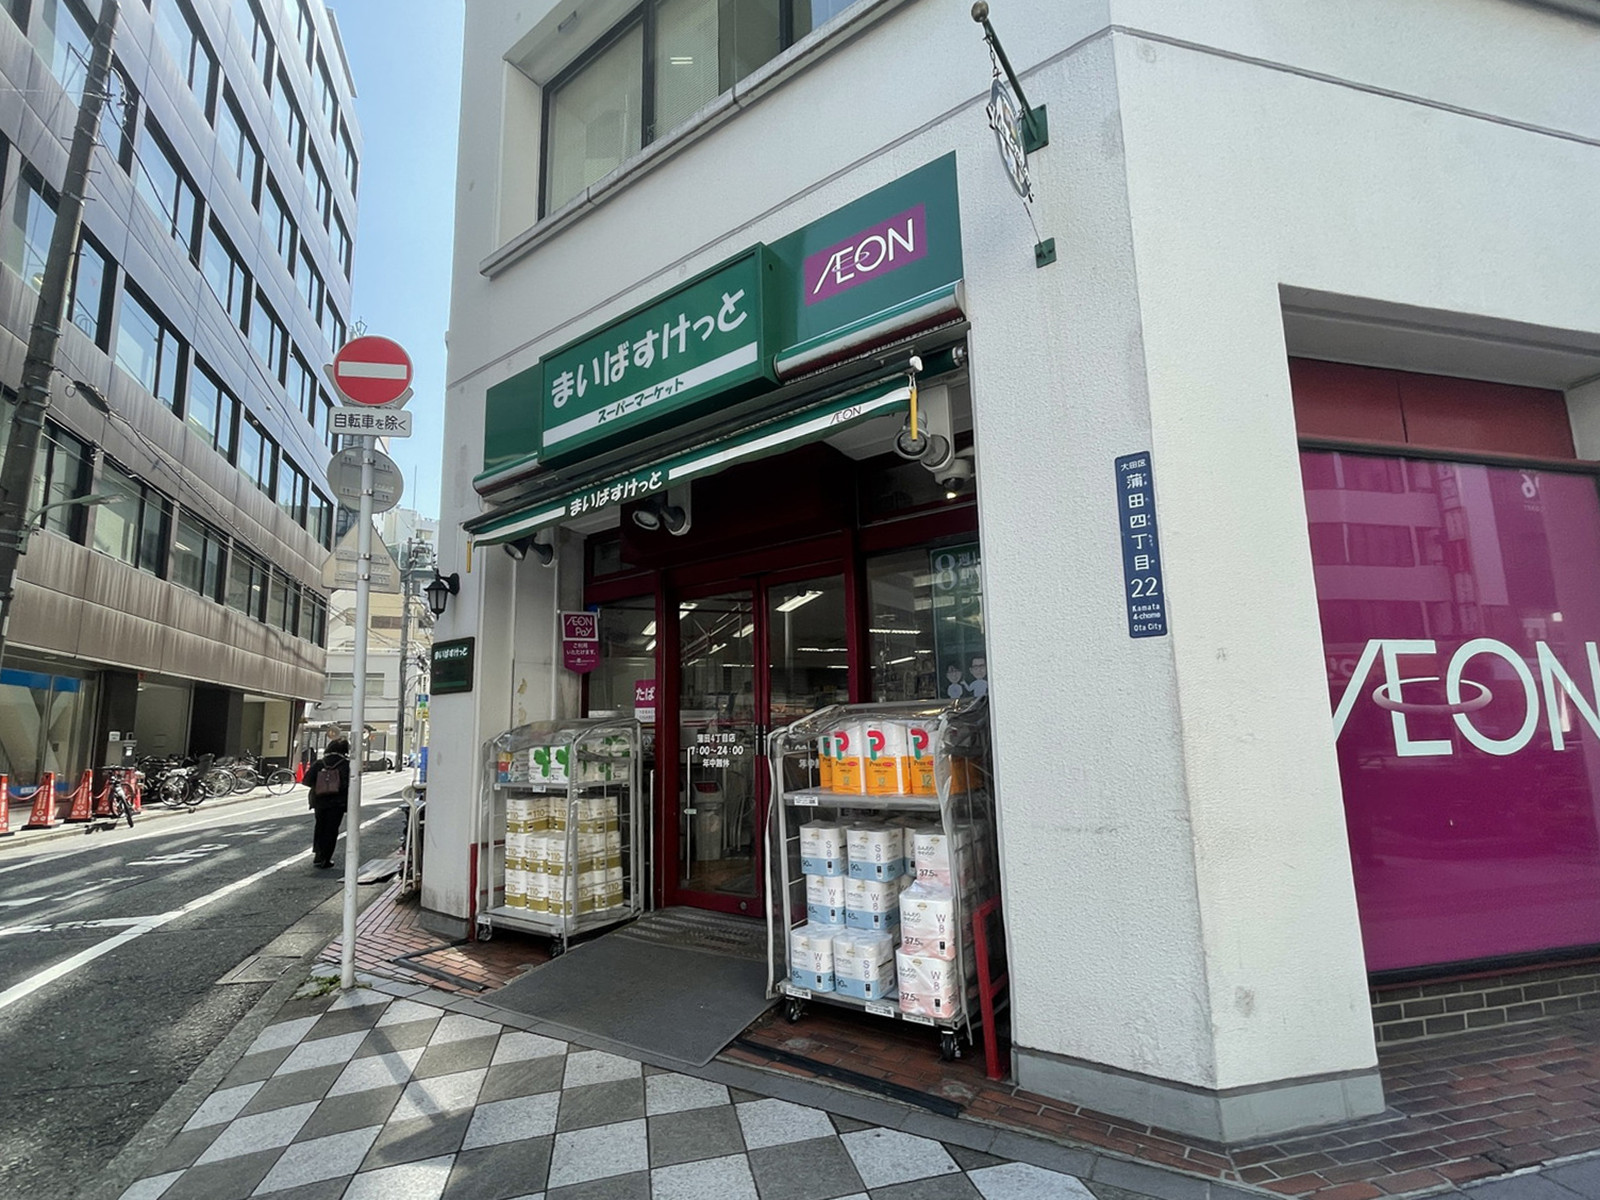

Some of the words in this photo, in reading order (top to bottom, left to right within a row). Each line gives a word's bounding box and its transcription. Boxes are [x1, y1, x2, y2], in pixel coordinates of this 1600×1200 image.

[551, 288, 748, 409] まいばすけっと
[598, 377, 684, 423] スーパーマーケット
[334, 413, 406, 431] 自転車を除く
[1120, 458, 1147, 471] 大田区
[570, 470, 662, 517] まいばすけっと
[1126, 472, 1150, 571] 蒲田四丁目
[1131, 576, 1158, 598] 22
[1132, 603, 1160, 612] Kamata
[1133, 612, 1161, 620] 4-chome
[575, 627, 593, 637] Pay
[1133, 624, 1147, 632] Ota
[1147, 622, 1162, 631] City
[434, 646, 468, 660] まいばすけっと
[696, 733, 736, 743] 蒲田4丁目店
